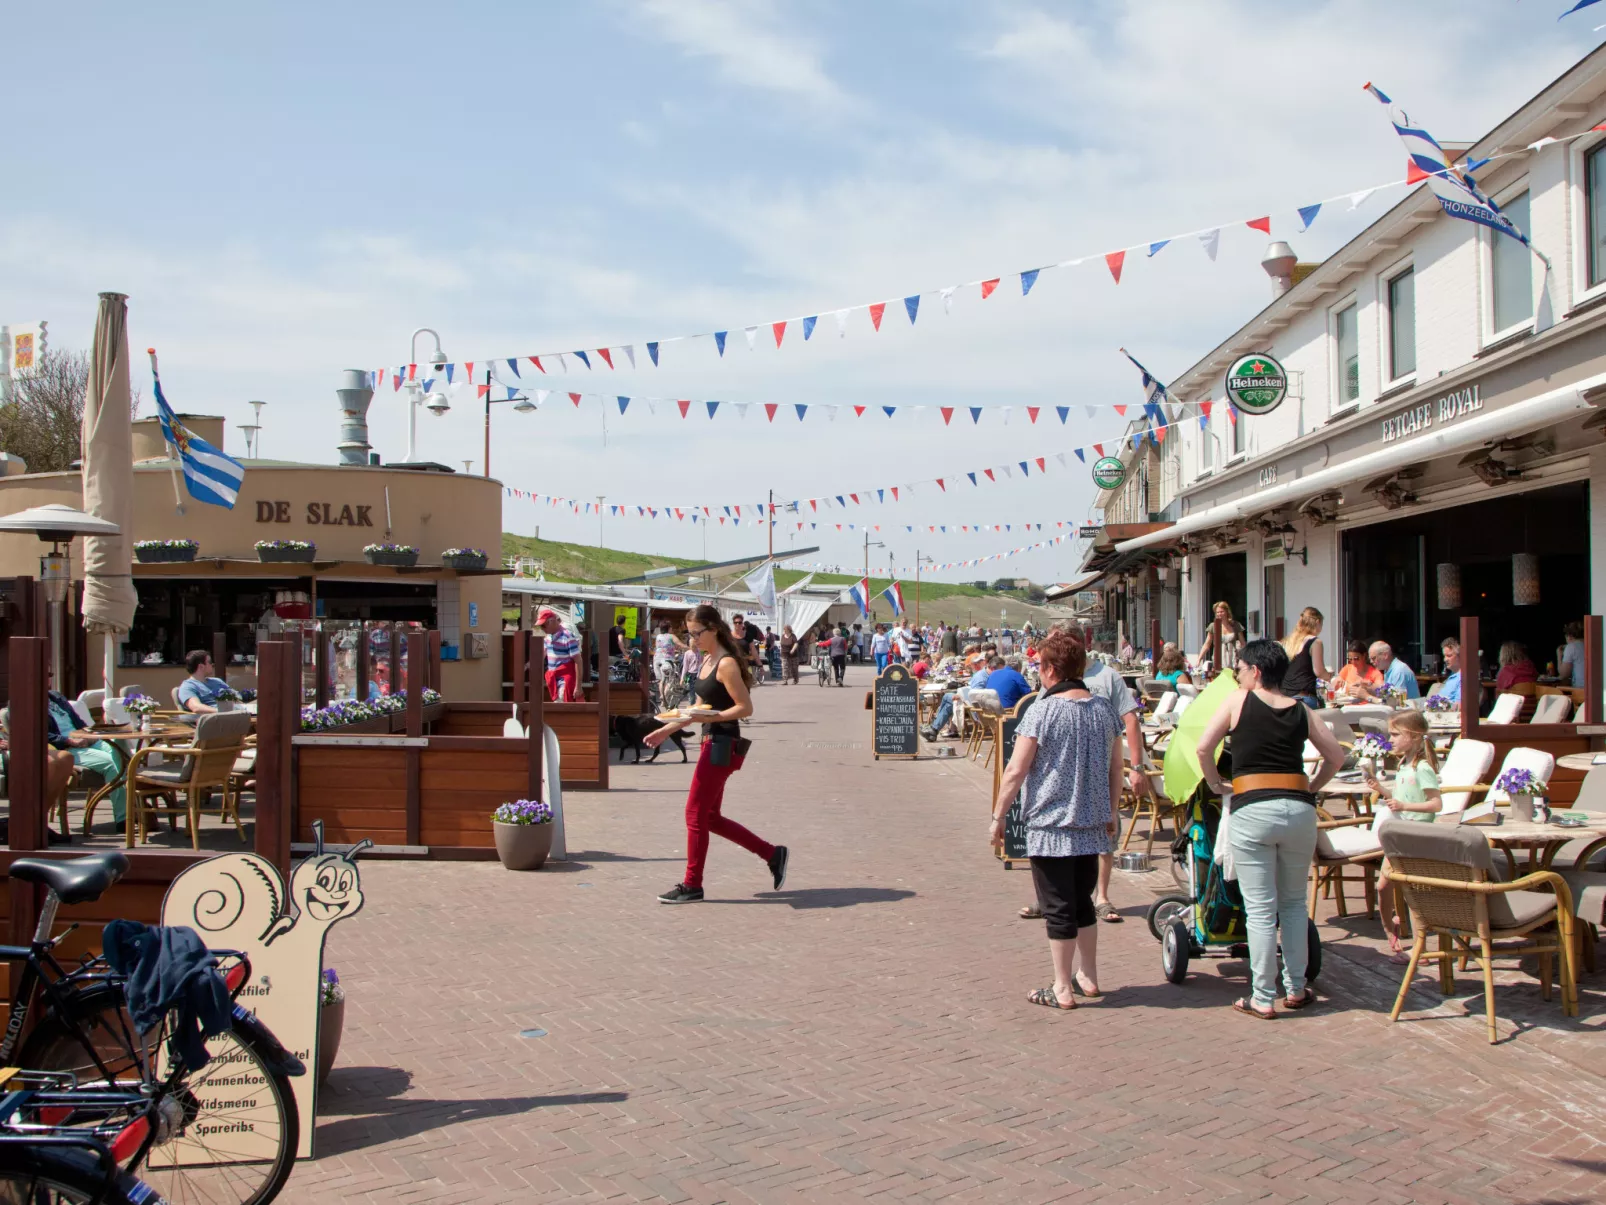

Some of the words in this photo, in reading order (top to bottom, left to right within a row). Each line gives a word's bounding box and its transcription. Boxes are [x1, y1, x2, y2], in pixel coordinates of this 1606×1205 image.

[1232, 377, 1282, 389] Heineken
[1382, 403, 1432, 443] EETCAFE
[1439, 385, 1484, 423] ROYAL
[256, 500, 291, 523] DE
[307, 502, 373, 527] SLAK
[880, 704, 917, 714] HAMBURGER
[209, 1052, 256, 1065] amburg
[199, 1098, 257, 1110] Kidsmenu
[196, 1122, 254, 1136] Spareribs
